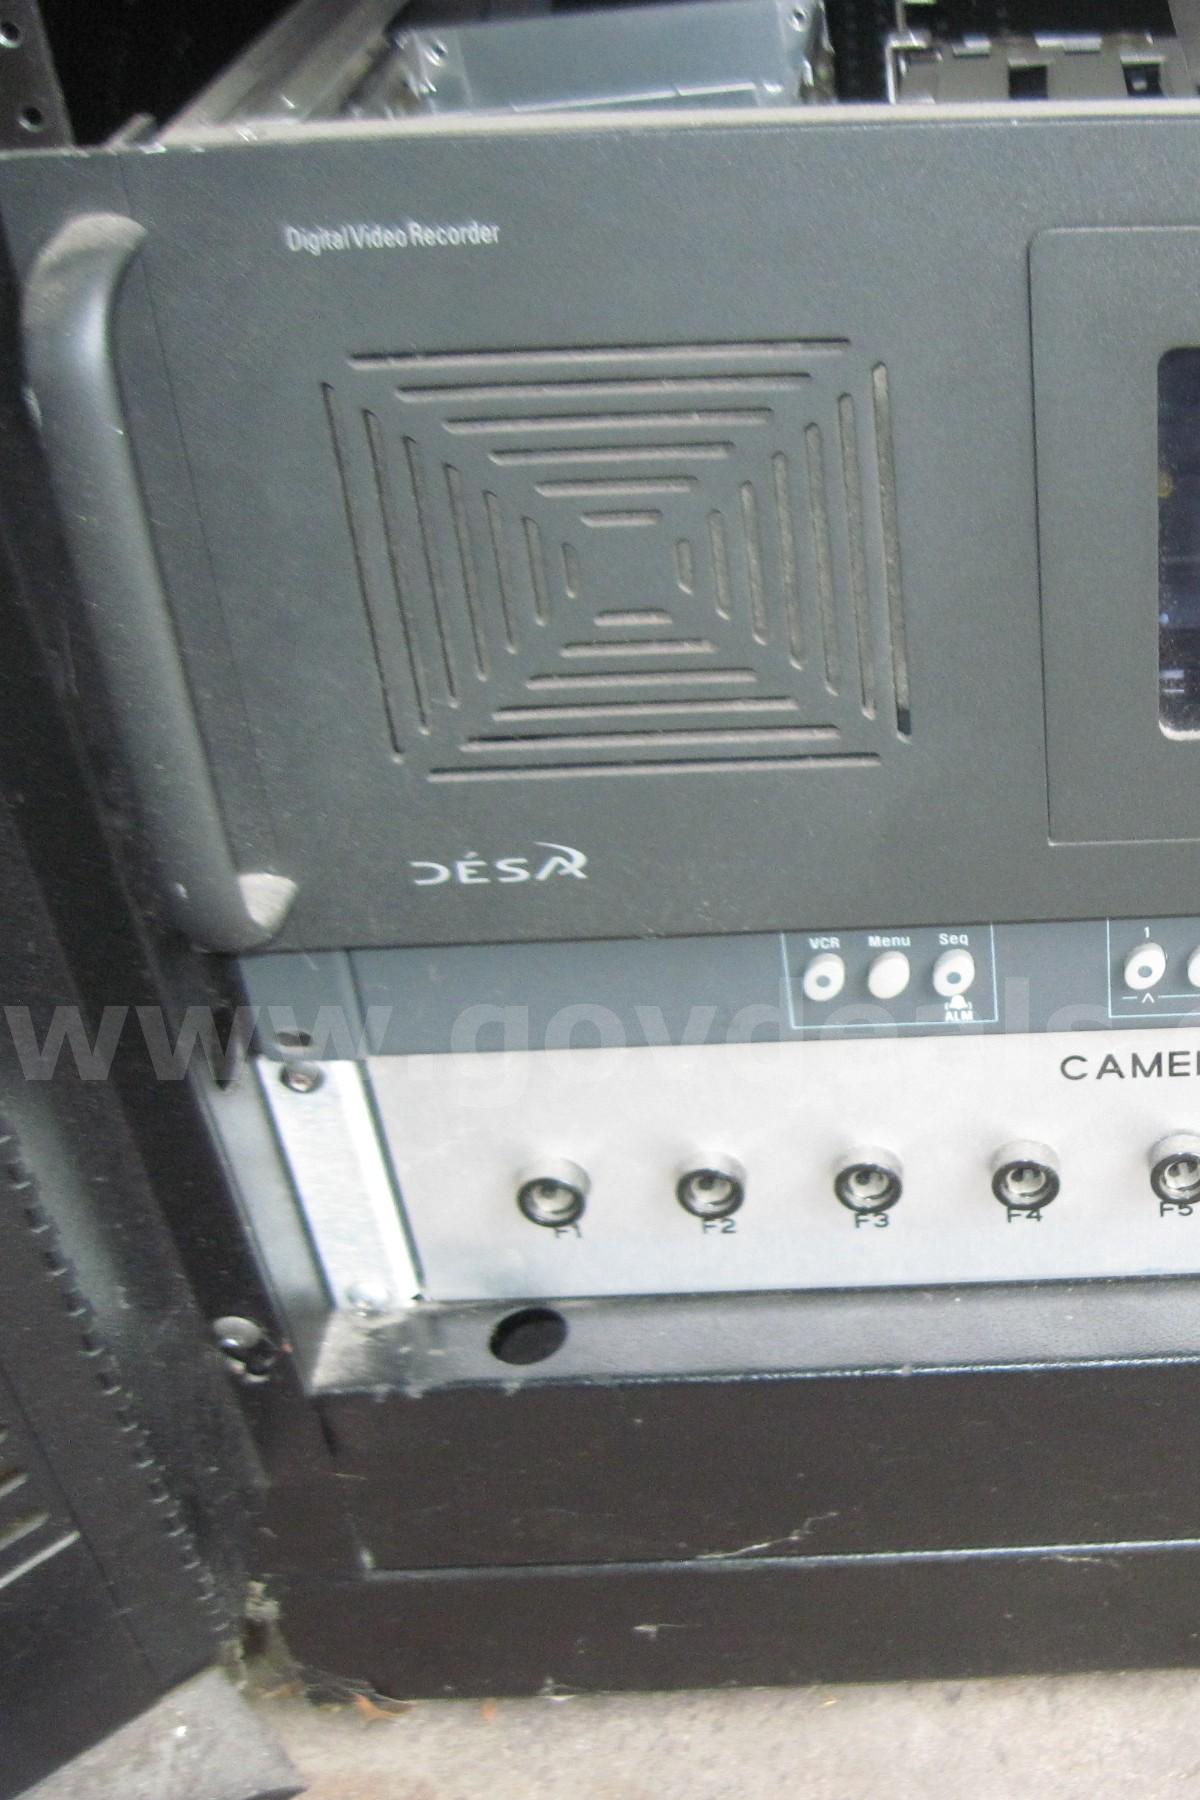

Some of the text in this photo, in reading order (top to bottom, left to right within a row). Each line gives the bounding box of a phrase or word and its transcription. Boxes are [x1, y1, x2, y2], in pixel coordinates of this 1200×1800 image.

[284, 218, 499, 256] Digital Video Recorder
[938, 932, 969, 947] Seq
[1143, 926, 1151, 939] 1
[808, 936, 841, 950] VCR
[867, 935, 911, 948] Menu
[944, 1010, 974, 1022] ALM
[1006, 1207, 1043, 1224] F4
[1159, 1200, 1194, 1218] F5
[702, 1217, 738, 1235] F2
[854, 1211, 891, 1229] F3
